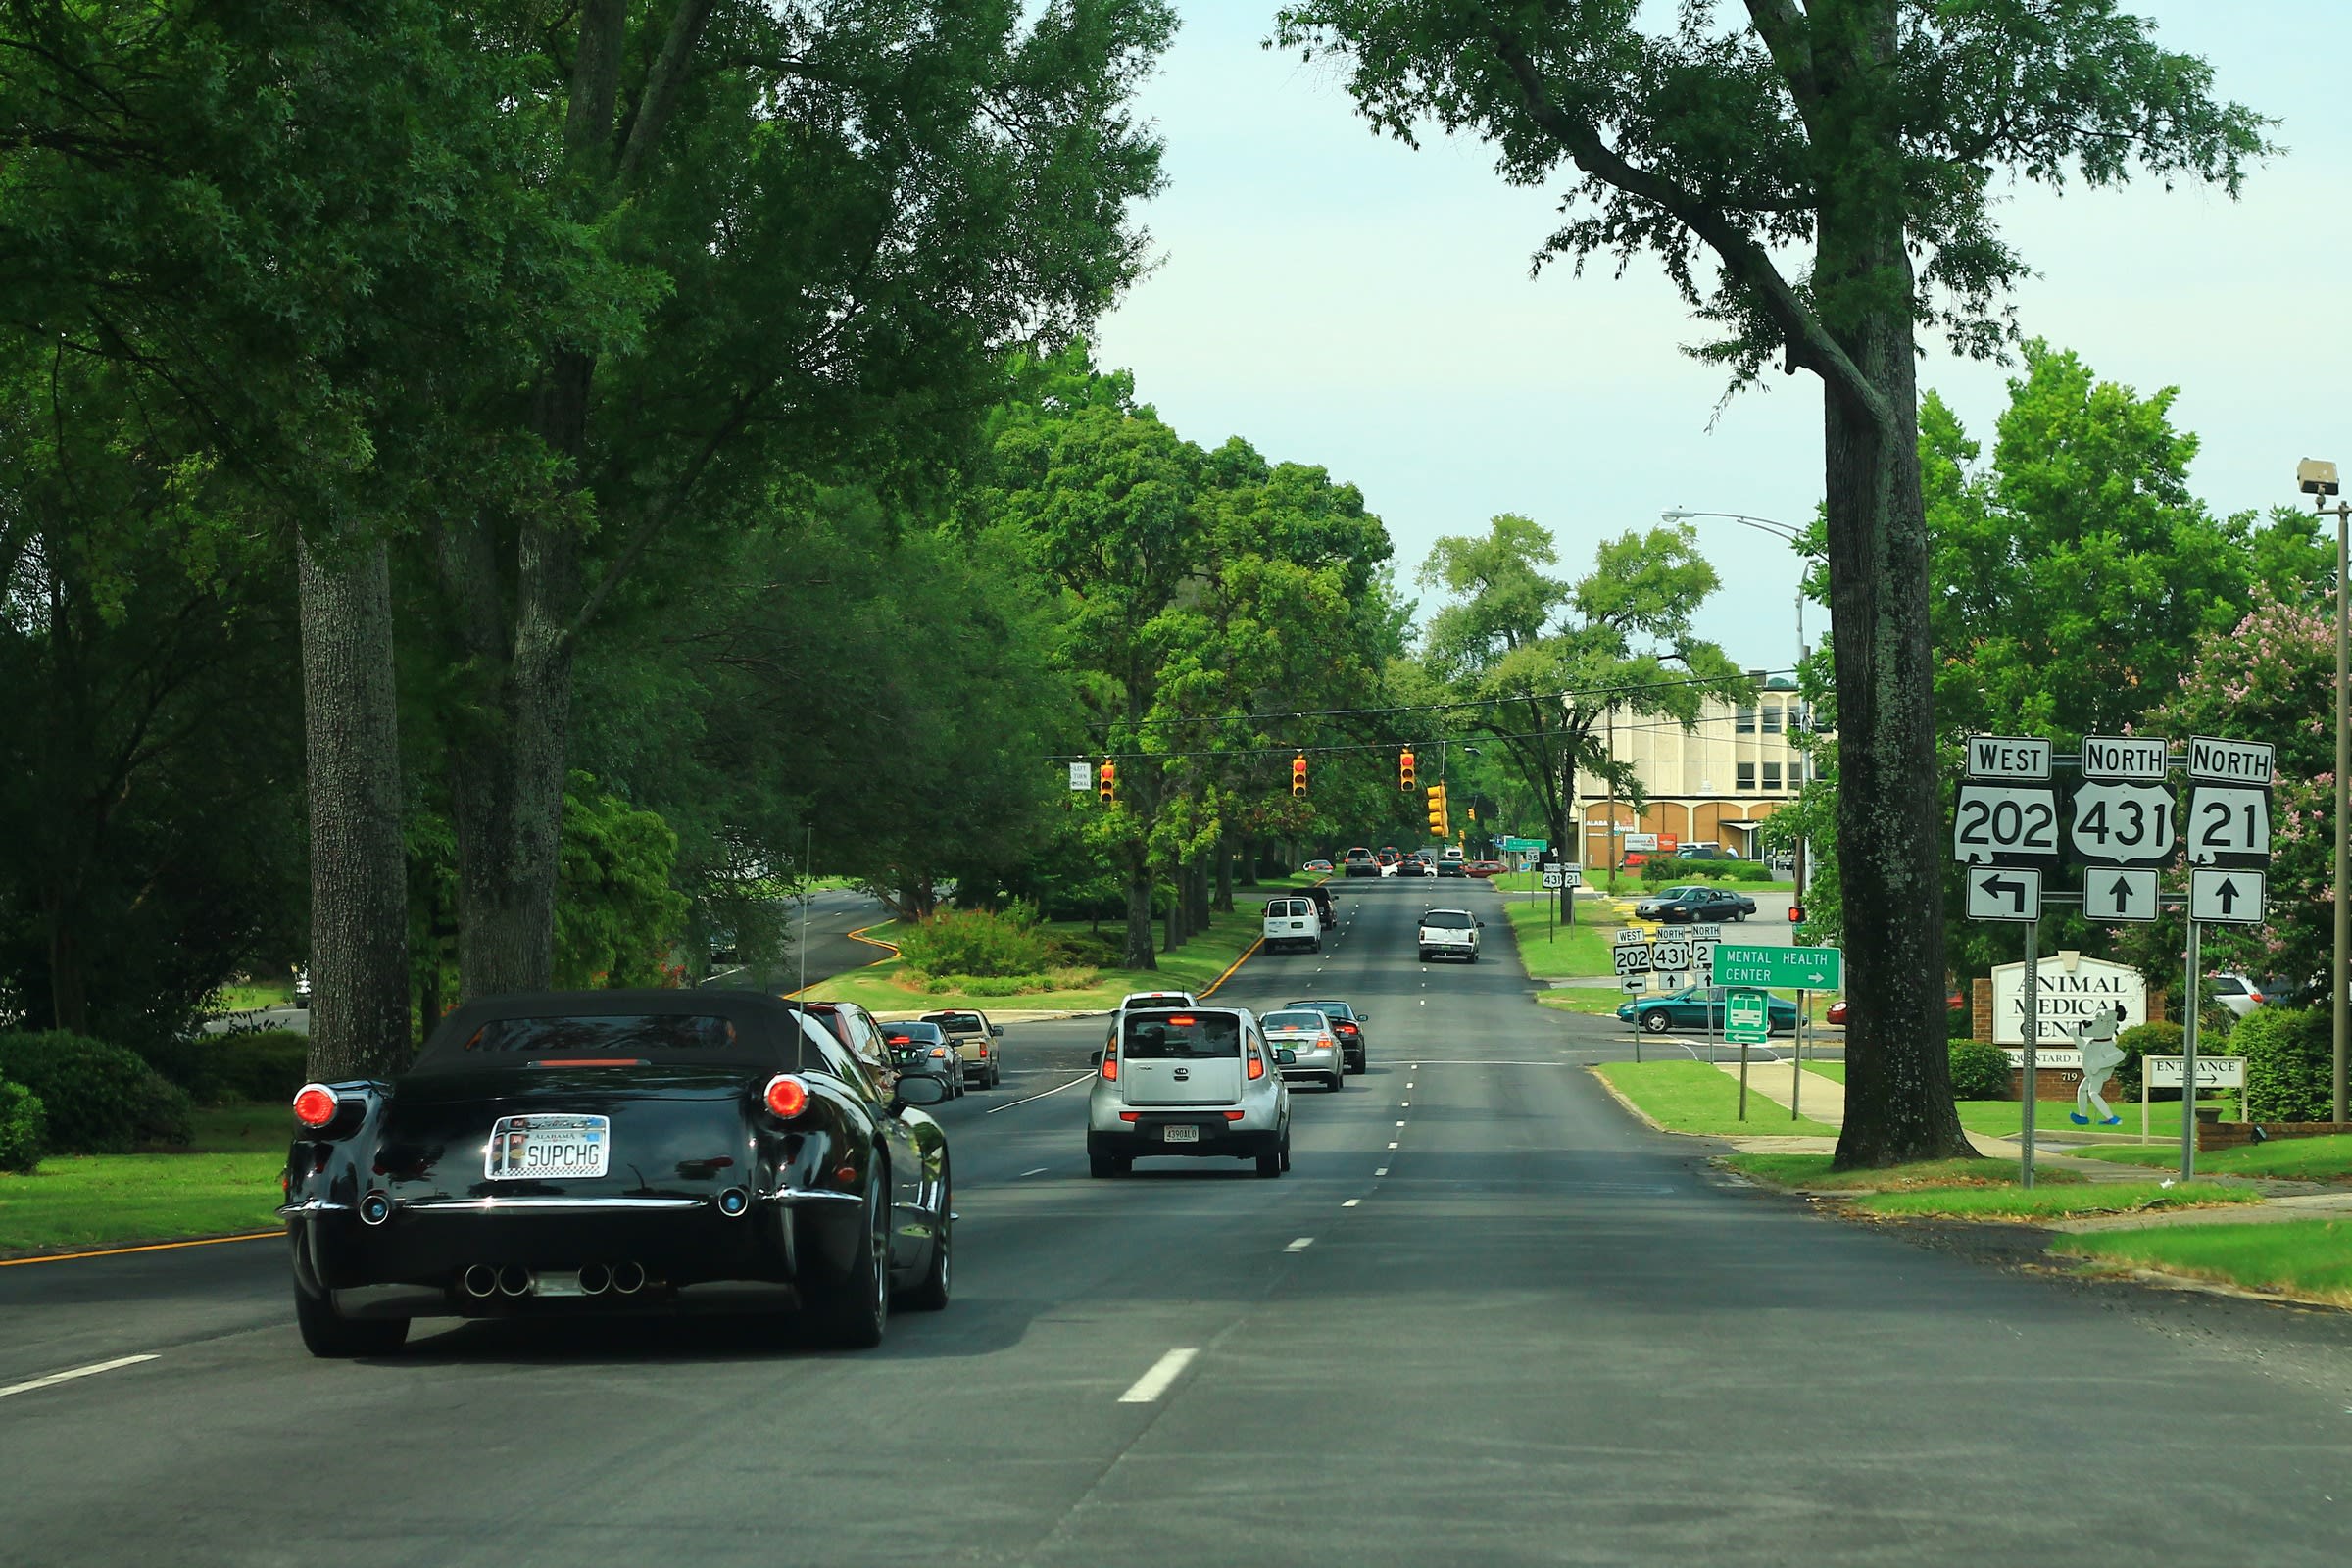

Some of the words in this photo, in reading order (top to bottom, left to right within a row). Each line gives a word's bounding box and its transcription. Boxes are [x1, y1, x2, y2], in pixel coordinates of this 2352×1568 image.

[1979, 744, 2041, 772] WEST
[2088, 743, 2163, 772] NORTH
[2193, 744, 2269, 777] NORTH
[1960, 800, 2053, 847] 202
[2078, 800, 2165, 848] 431
[2202, 802, 2255, 848] 21
[1544, 875, 1561, 884] 431
[1567, 875, 1578, 884] 21
[1619, 930, 1642, 942] WEST
[1657, 928, 1684, 939] NORTH
[1693, 926, 1719, 936] NORTH
[1617, 951, 1648, 968] 202
[1656, 949, 1685, 964] 431
[1727, 951, 1772, 963] MENTAL
[1783, 953, 1828, 965] HEALTH
[1726, 968, 1771, 981] CENTER
[2020, 1021, 2120, 1037] ENT
[2012, 1054, 2071, 1063] QTARD
[2157, 1061, 2235, 1072] ENTANCE
[2061, 1072, 2078, 1081] 719
[528, 1144, 599, 1167] SUPCHG
